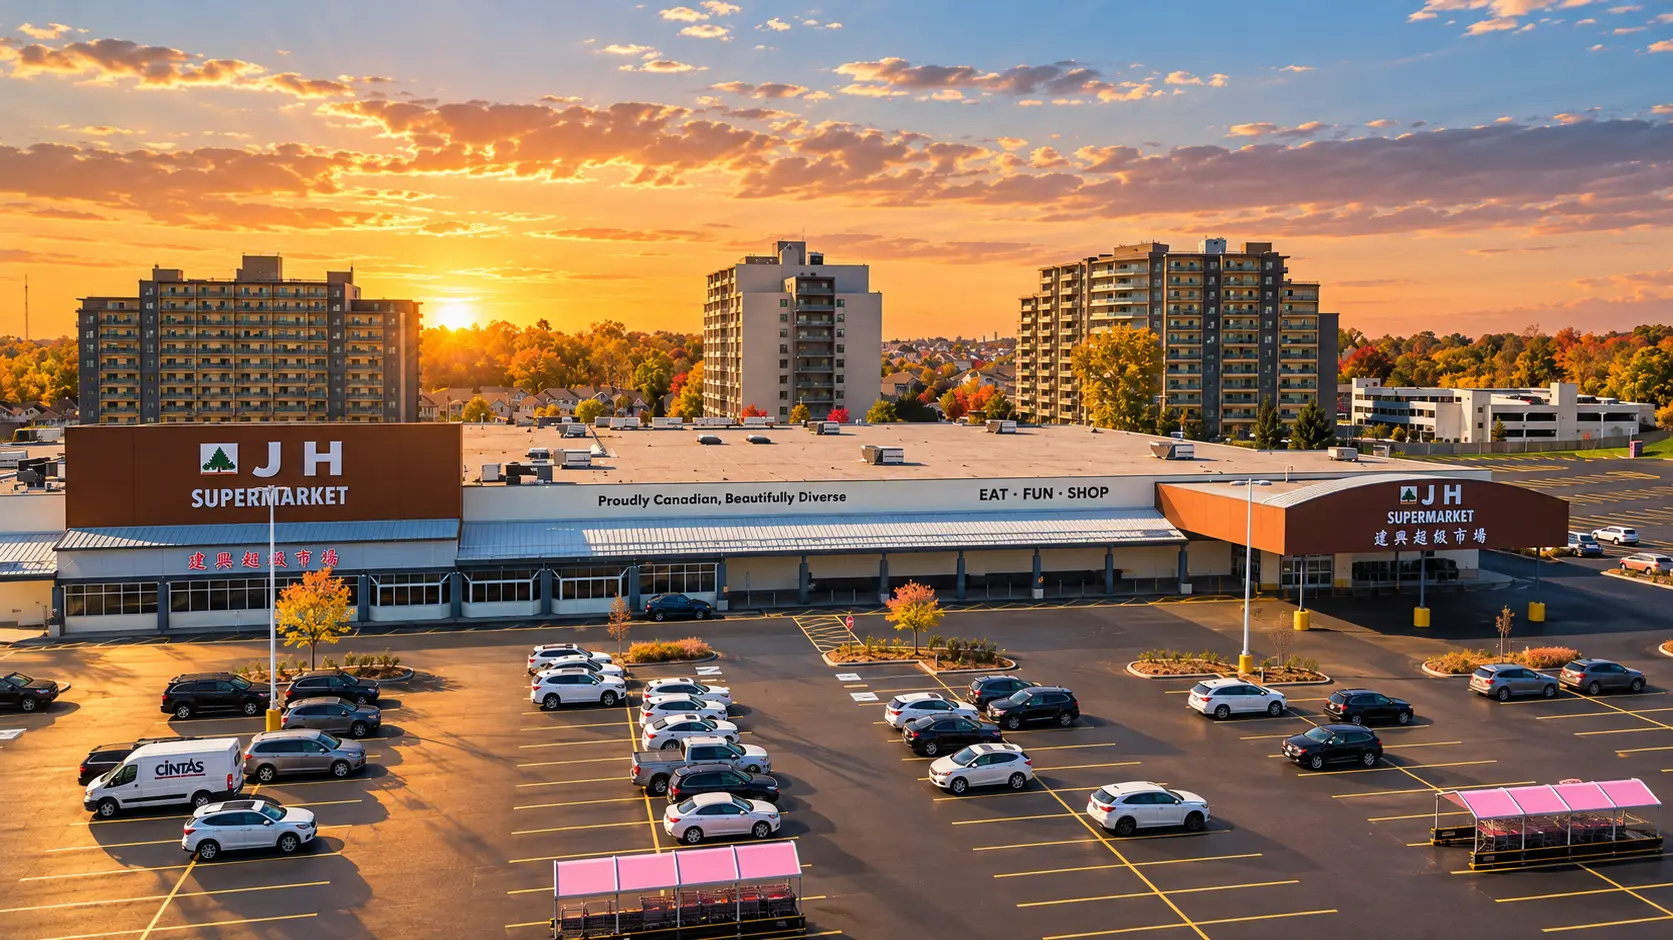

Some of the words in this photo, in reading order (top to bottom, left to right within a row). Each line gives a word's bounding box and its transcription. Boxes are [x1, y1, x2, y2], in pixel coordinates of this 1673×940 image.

[252, 441, 281, 477] J
[304, 441, 342, 476] H
[191, 486, 349, 508] SUPERMARKET
[598, 494, 640, 509] Proudly
[653, 493, 722, 506] Canadian,
[725, 491, 795, 506] Beautifully
[798, 491, 847, 502] Diverse
[979, 488, 1009, 501] EAT
[1023, 487, 1054, 500] FUN
[1067, 486, 1110, 499] SHOP
[1387, 510, 1474, 524] SUPERMARKET
